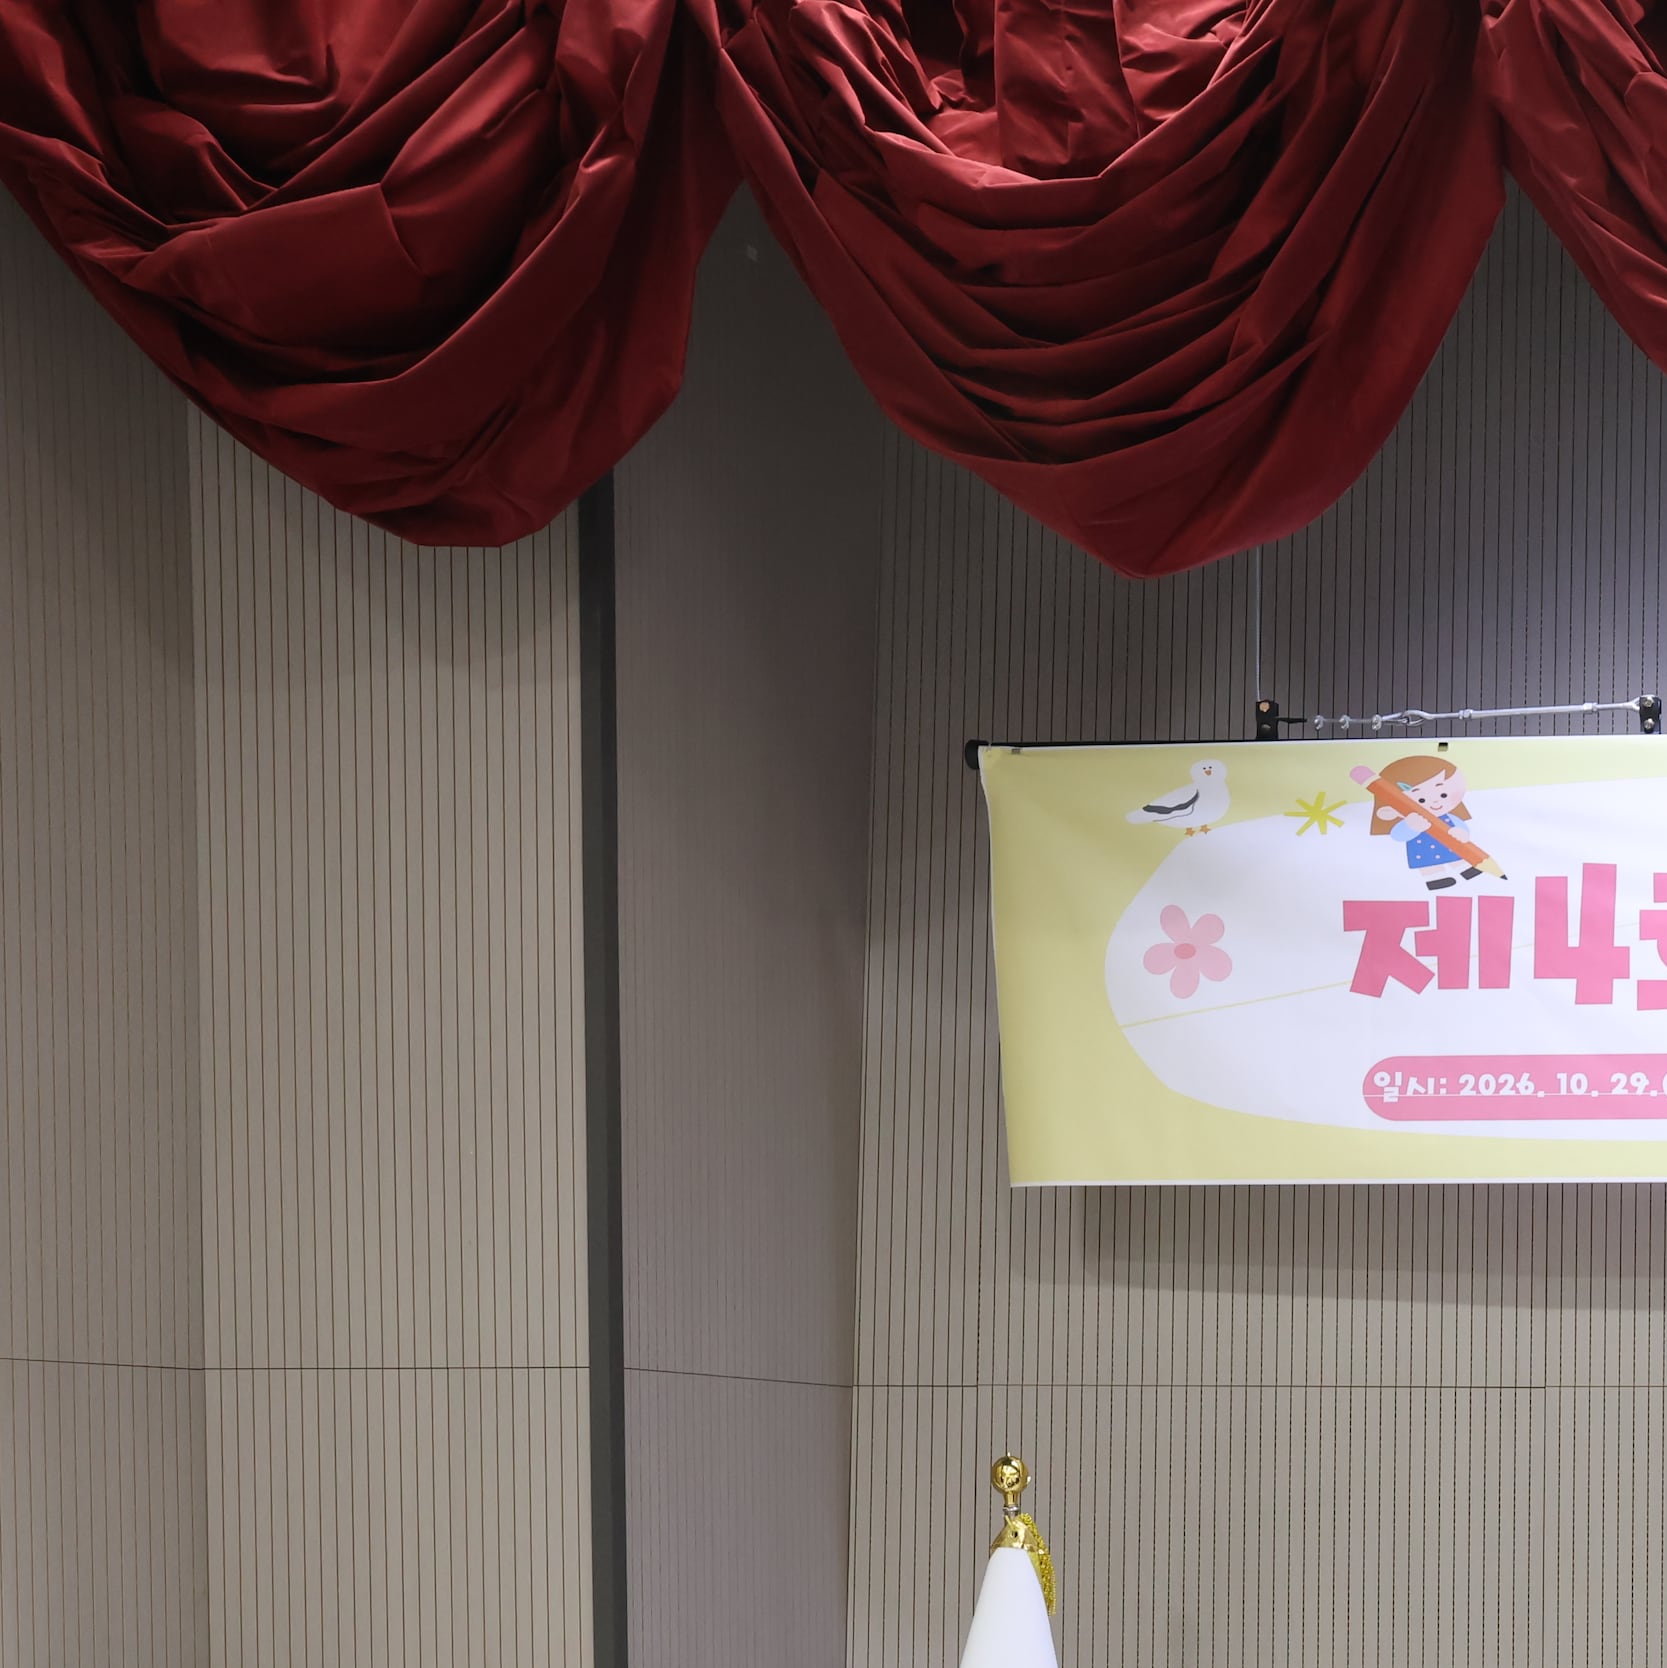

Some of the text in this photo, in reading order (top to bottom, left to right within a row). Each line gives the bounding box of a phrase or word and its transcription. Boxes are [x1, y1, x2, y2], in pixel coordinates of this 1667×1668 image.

[1373, 1069, 1447, 1102] 일시:
[1459, 1073, 1545, 1097] 2026.
[1557, 1073, 1599, 1097] 10.
